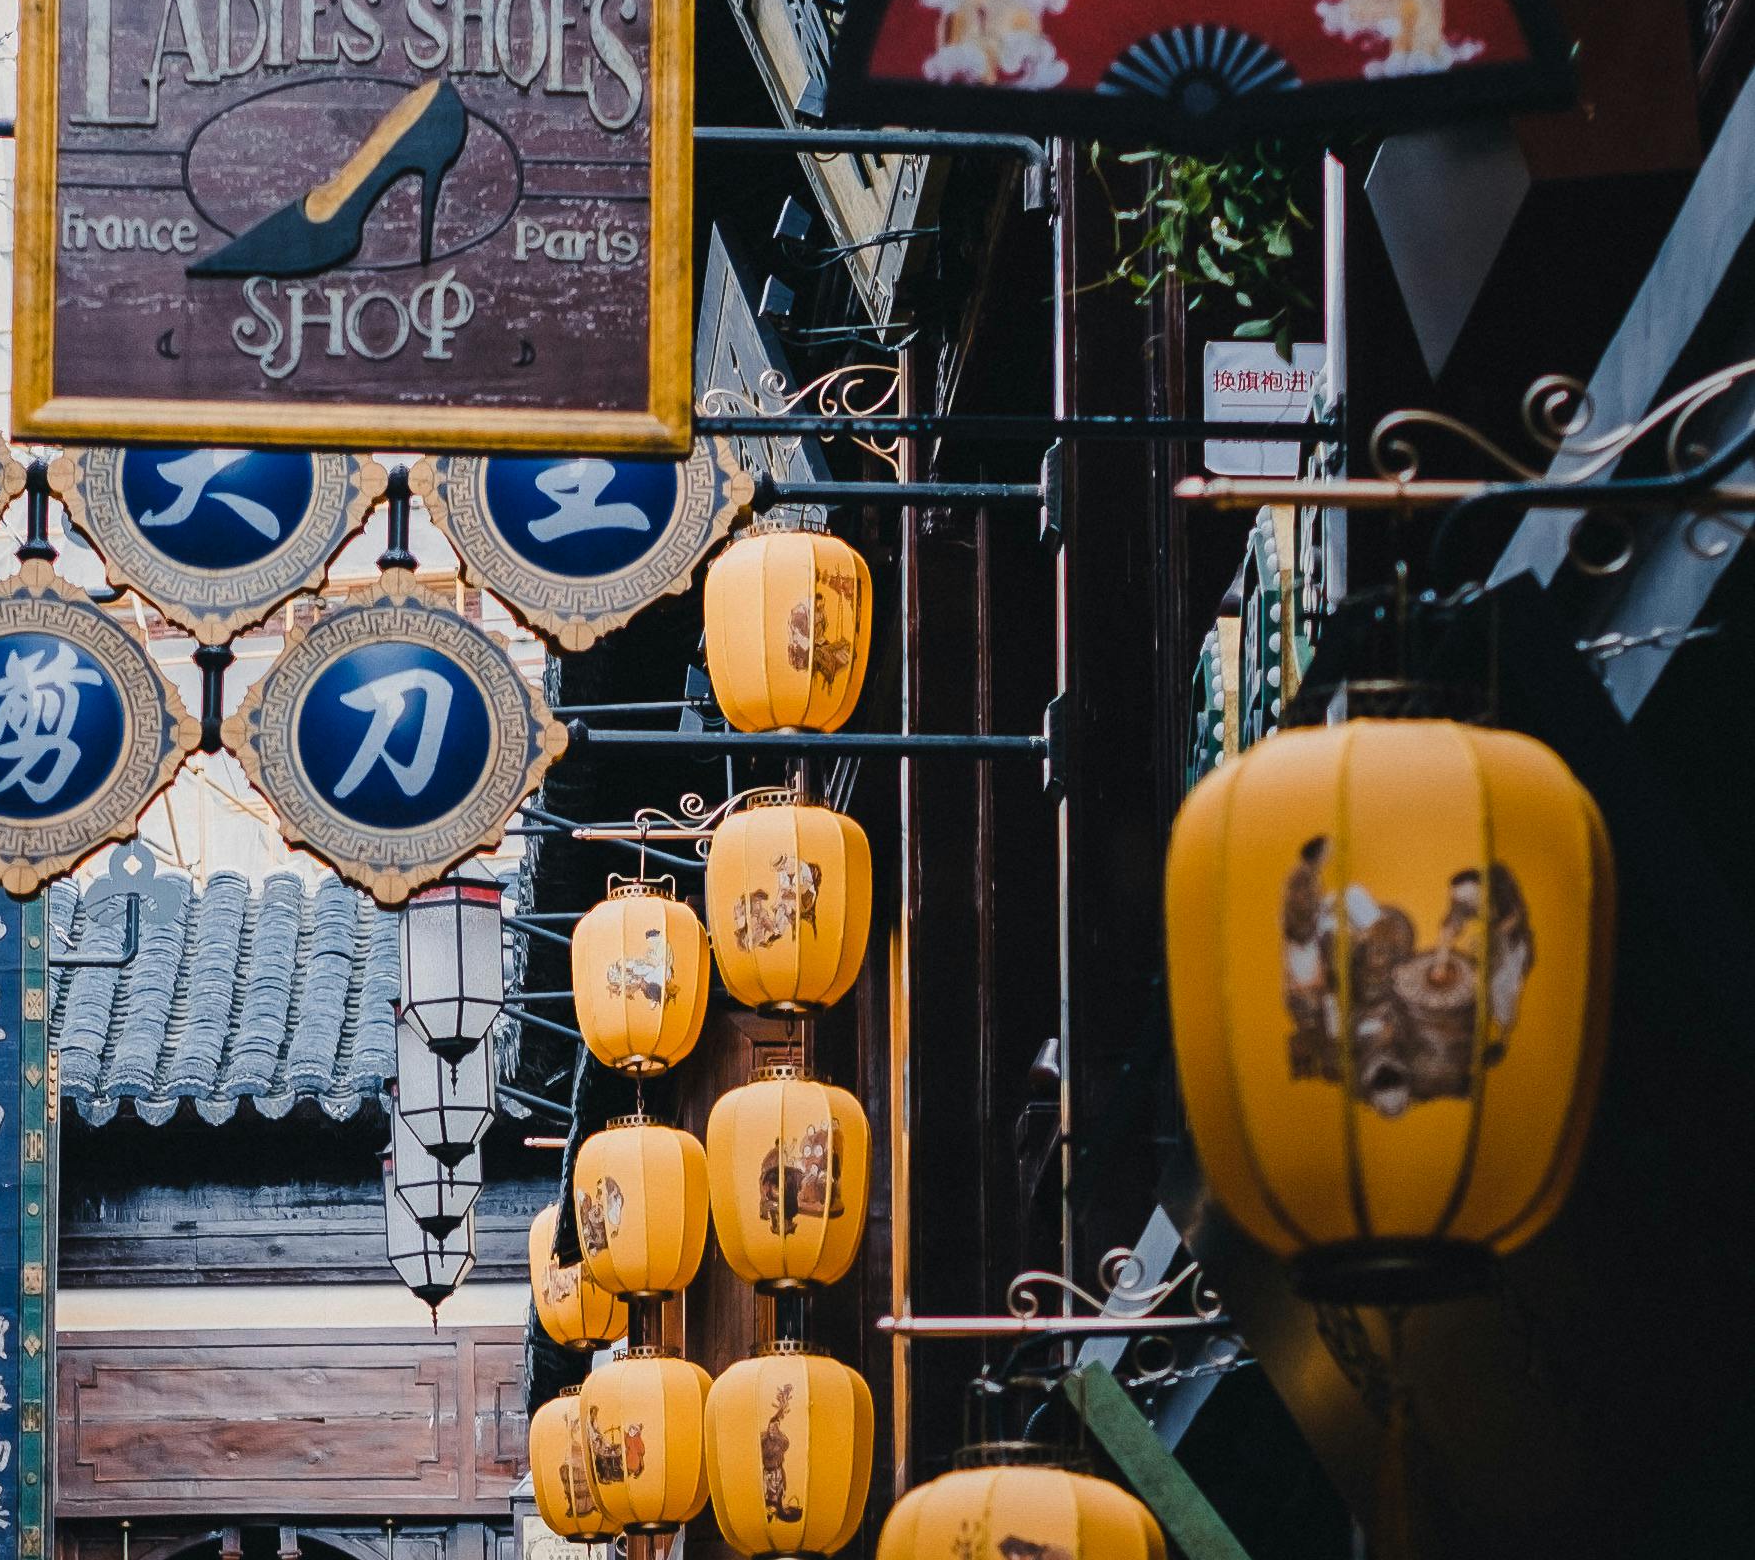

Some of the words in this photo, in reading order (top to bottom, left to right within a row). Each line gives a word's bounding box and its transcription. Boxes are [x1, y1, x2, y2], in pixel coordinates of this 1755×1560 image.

[60, 206, 200, 255] France
[513, 218, 641, 266] Paris
[230, 268, 477, 382] SHOP
